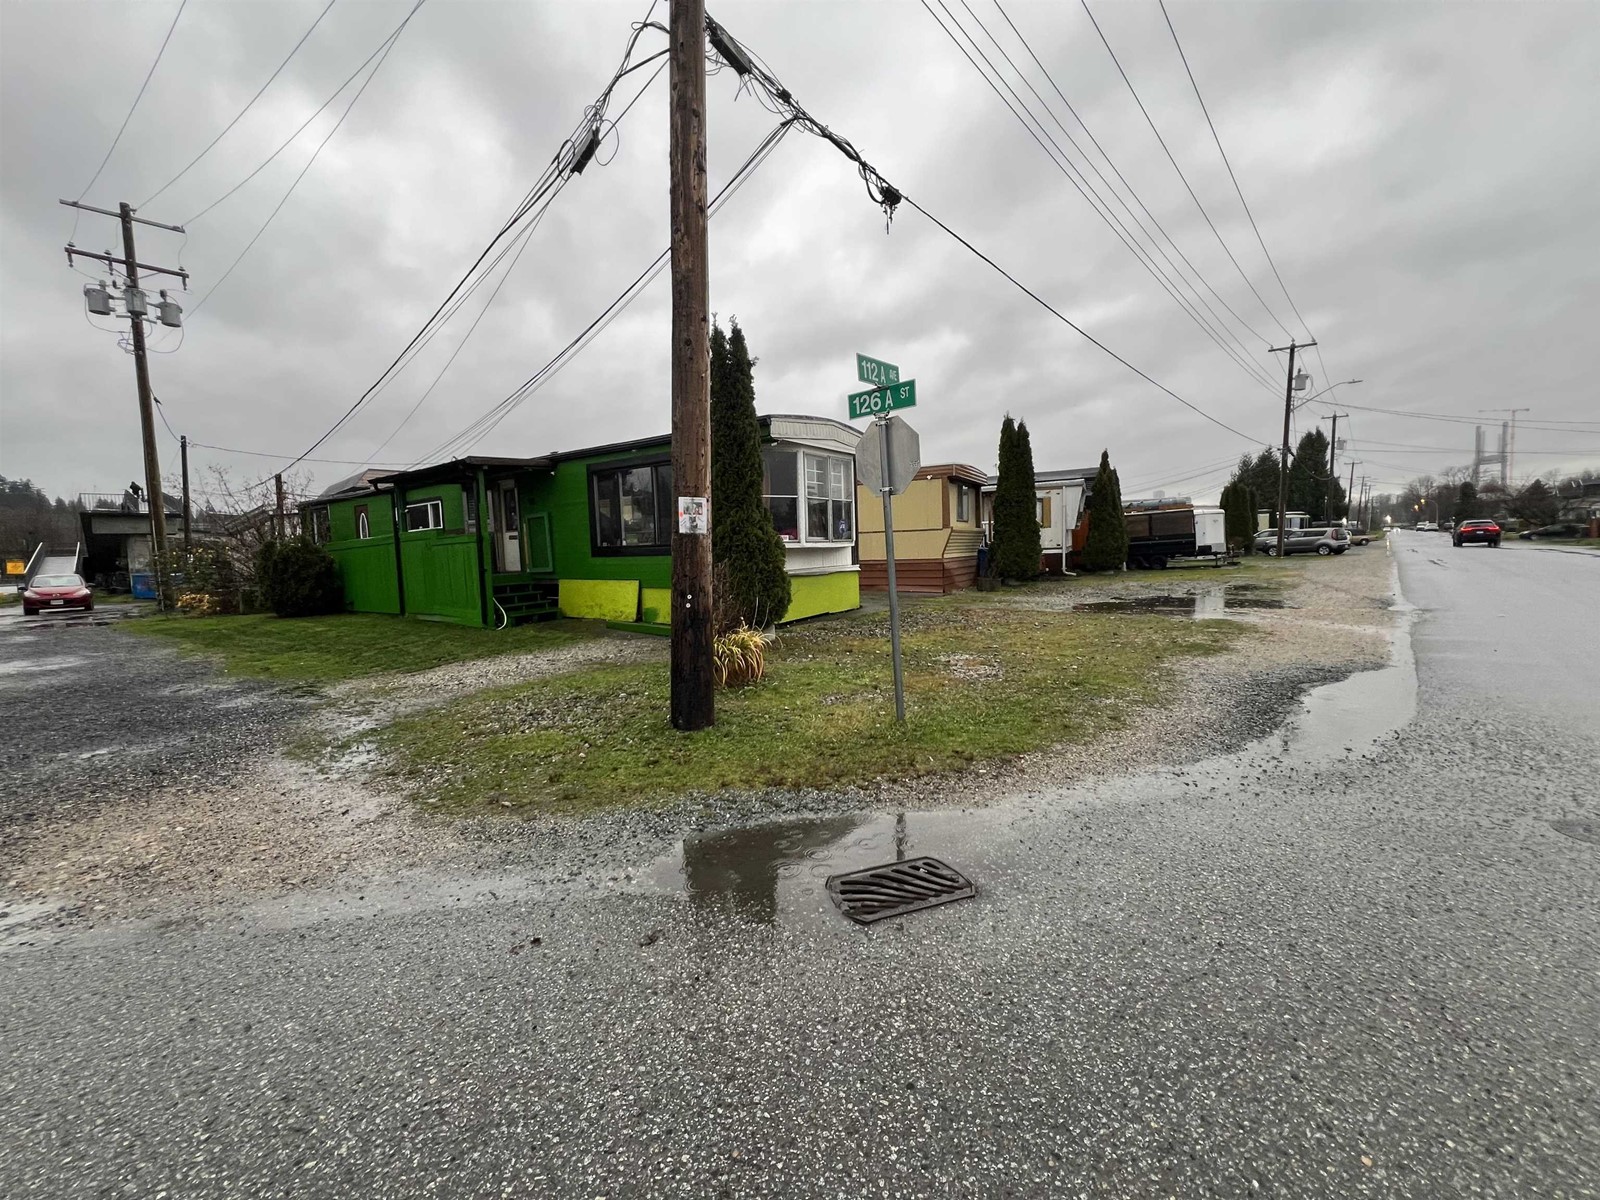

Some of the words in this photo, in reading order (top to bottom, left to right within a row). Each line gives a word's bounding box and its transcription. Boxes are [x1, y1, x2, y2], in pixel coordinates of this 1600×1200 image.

[862, 360, 878, 381] 112
[880, 366, 886, 384] A
[889, 369, 897, 381] AVE
[853, 392, 881, 414] 126
[885, 389, 893, 408] A
[900, 386, 909, 398] ST
